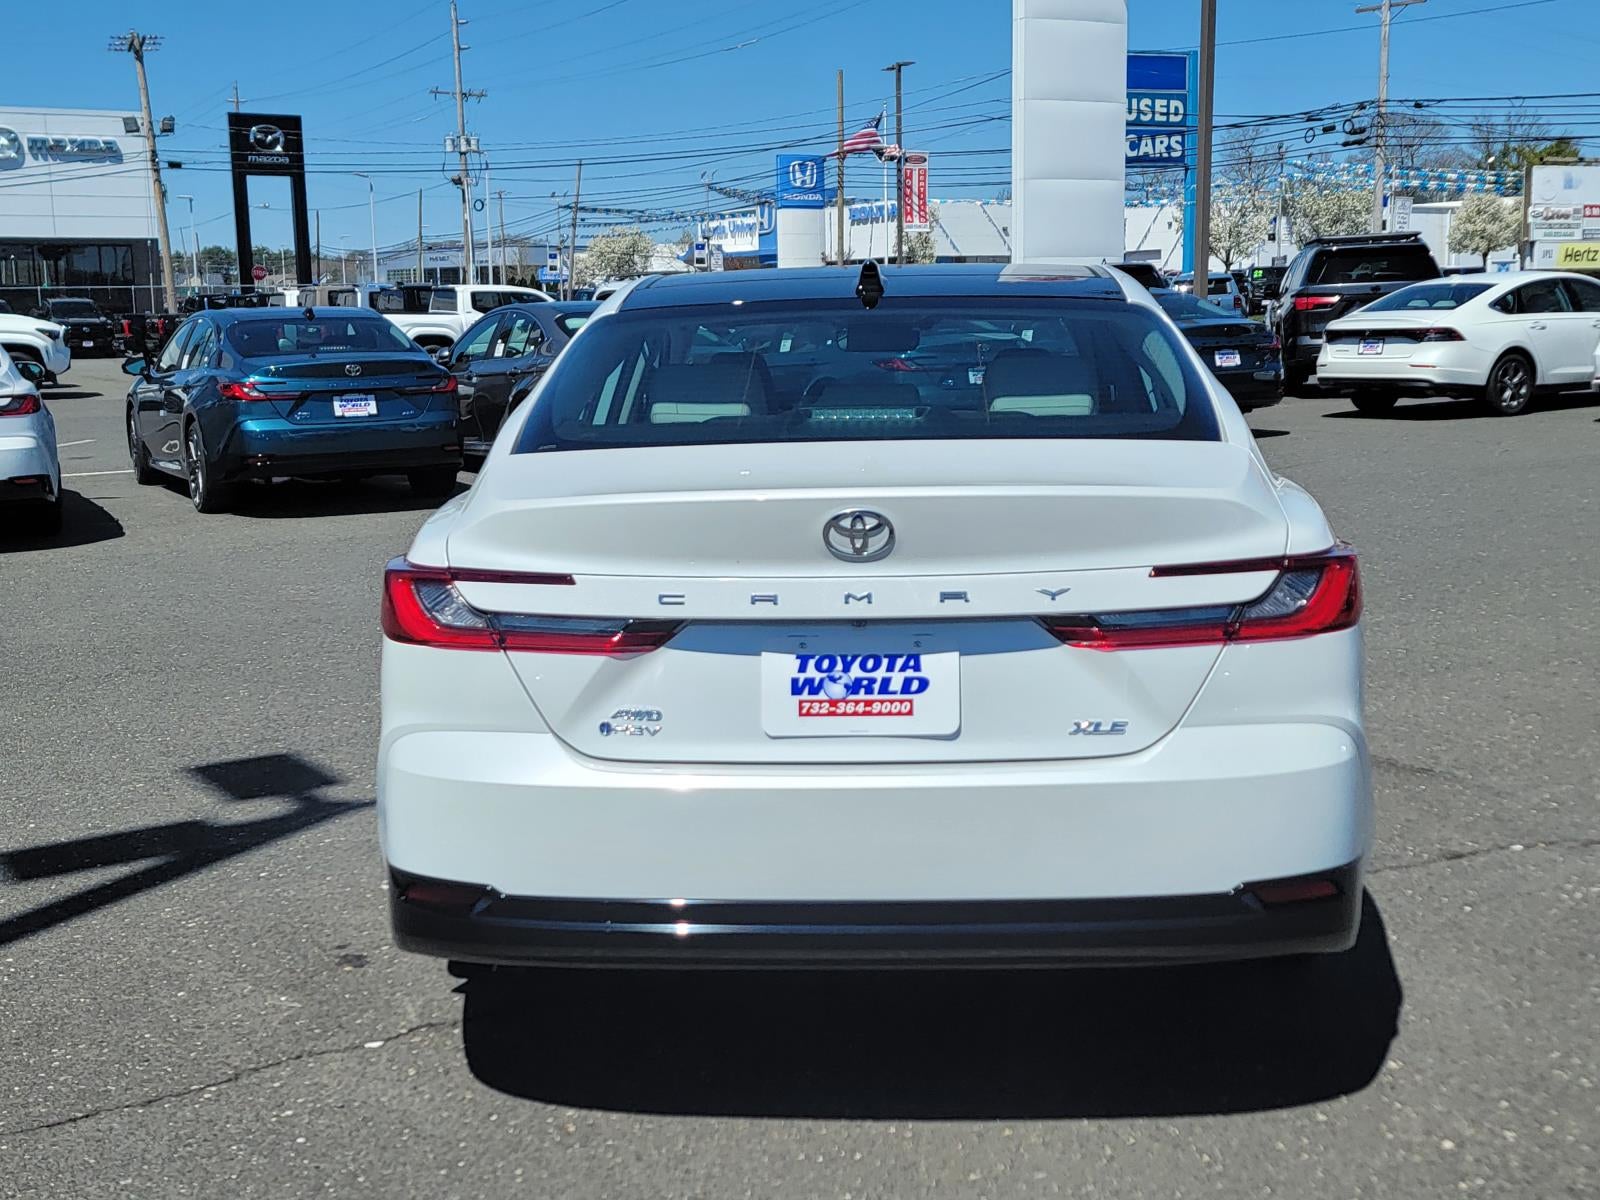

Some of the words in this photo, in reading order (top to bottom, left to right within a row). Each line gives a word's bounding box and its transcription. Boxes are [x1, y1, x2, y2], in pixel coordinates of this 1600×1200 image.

[1126, 98, 1184, 122] USED
[1126, 134, 1182, 157] CARS
[1563, 247, 1599, 262] Hertz
[658, 587, 1072, 606] CAMRY
[795, 654, 922, 673] TOYOTA
[611, 709, 663, 721] AWD
[801, 702, 912, 715] 732-364-9000
[1068, 720, 1129, 736] XLE
